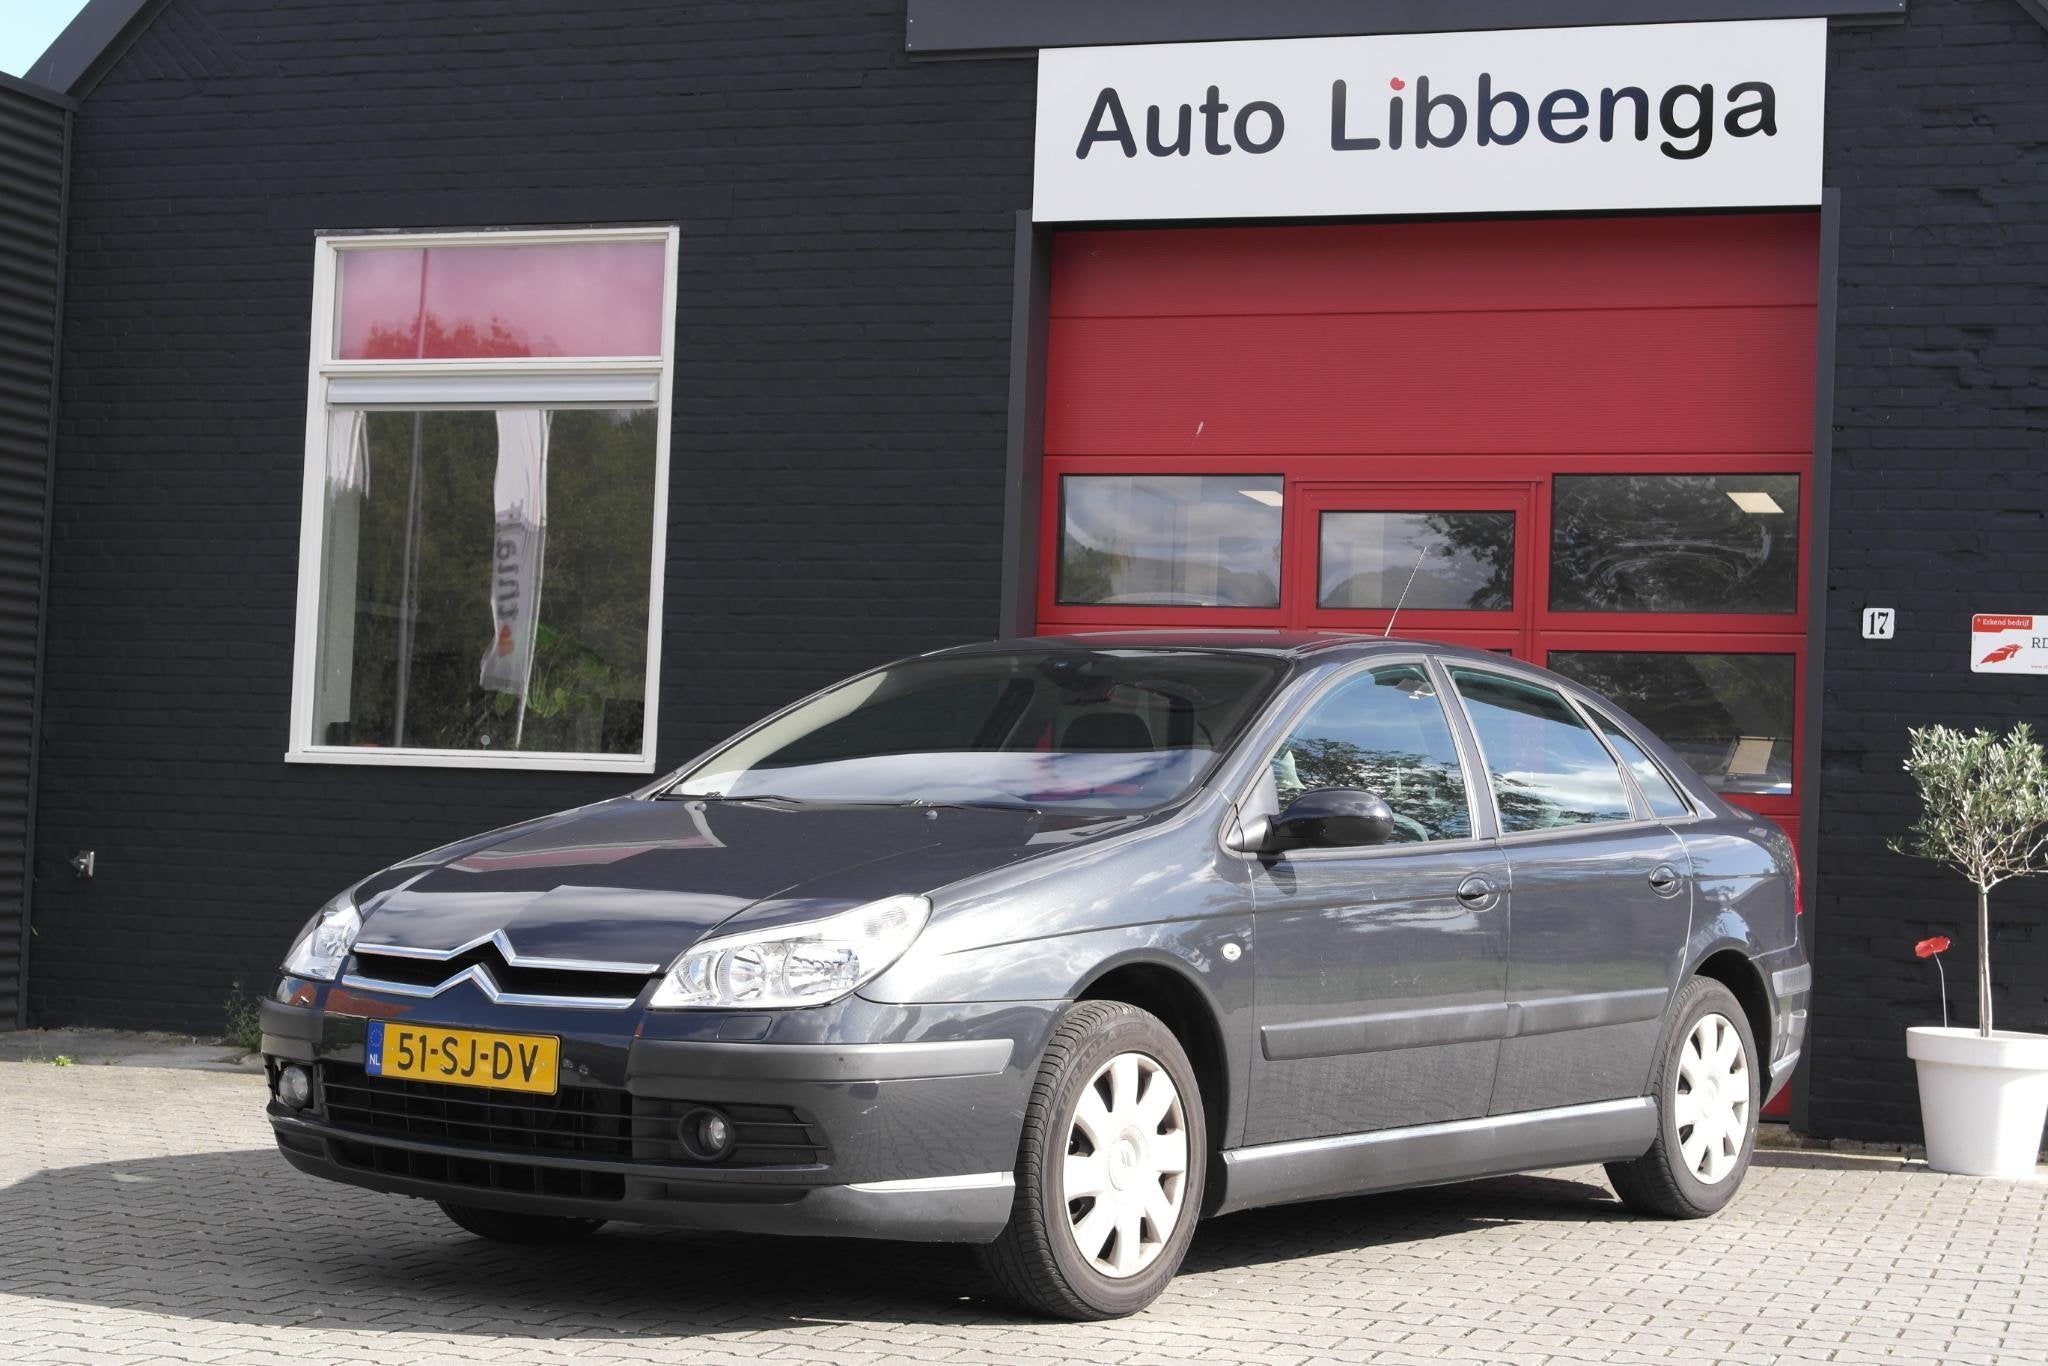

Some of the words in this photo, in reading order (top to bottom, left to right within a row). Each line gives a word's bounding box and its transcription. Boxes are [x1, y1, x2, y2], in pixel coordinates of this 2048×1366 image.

[1076, 86, 1285, 159] Auto
[1331, 73, 1778, 161] Libbenga
[1869, 611, 1889, 635] 17
[1982, 618, 2006, 626] Erkend
[2007, 619, 2030, 627] bedrijf
[369, 1053, 381, 1066] NL
[397, 1032, 539, 1083] 51-SJ-DV
